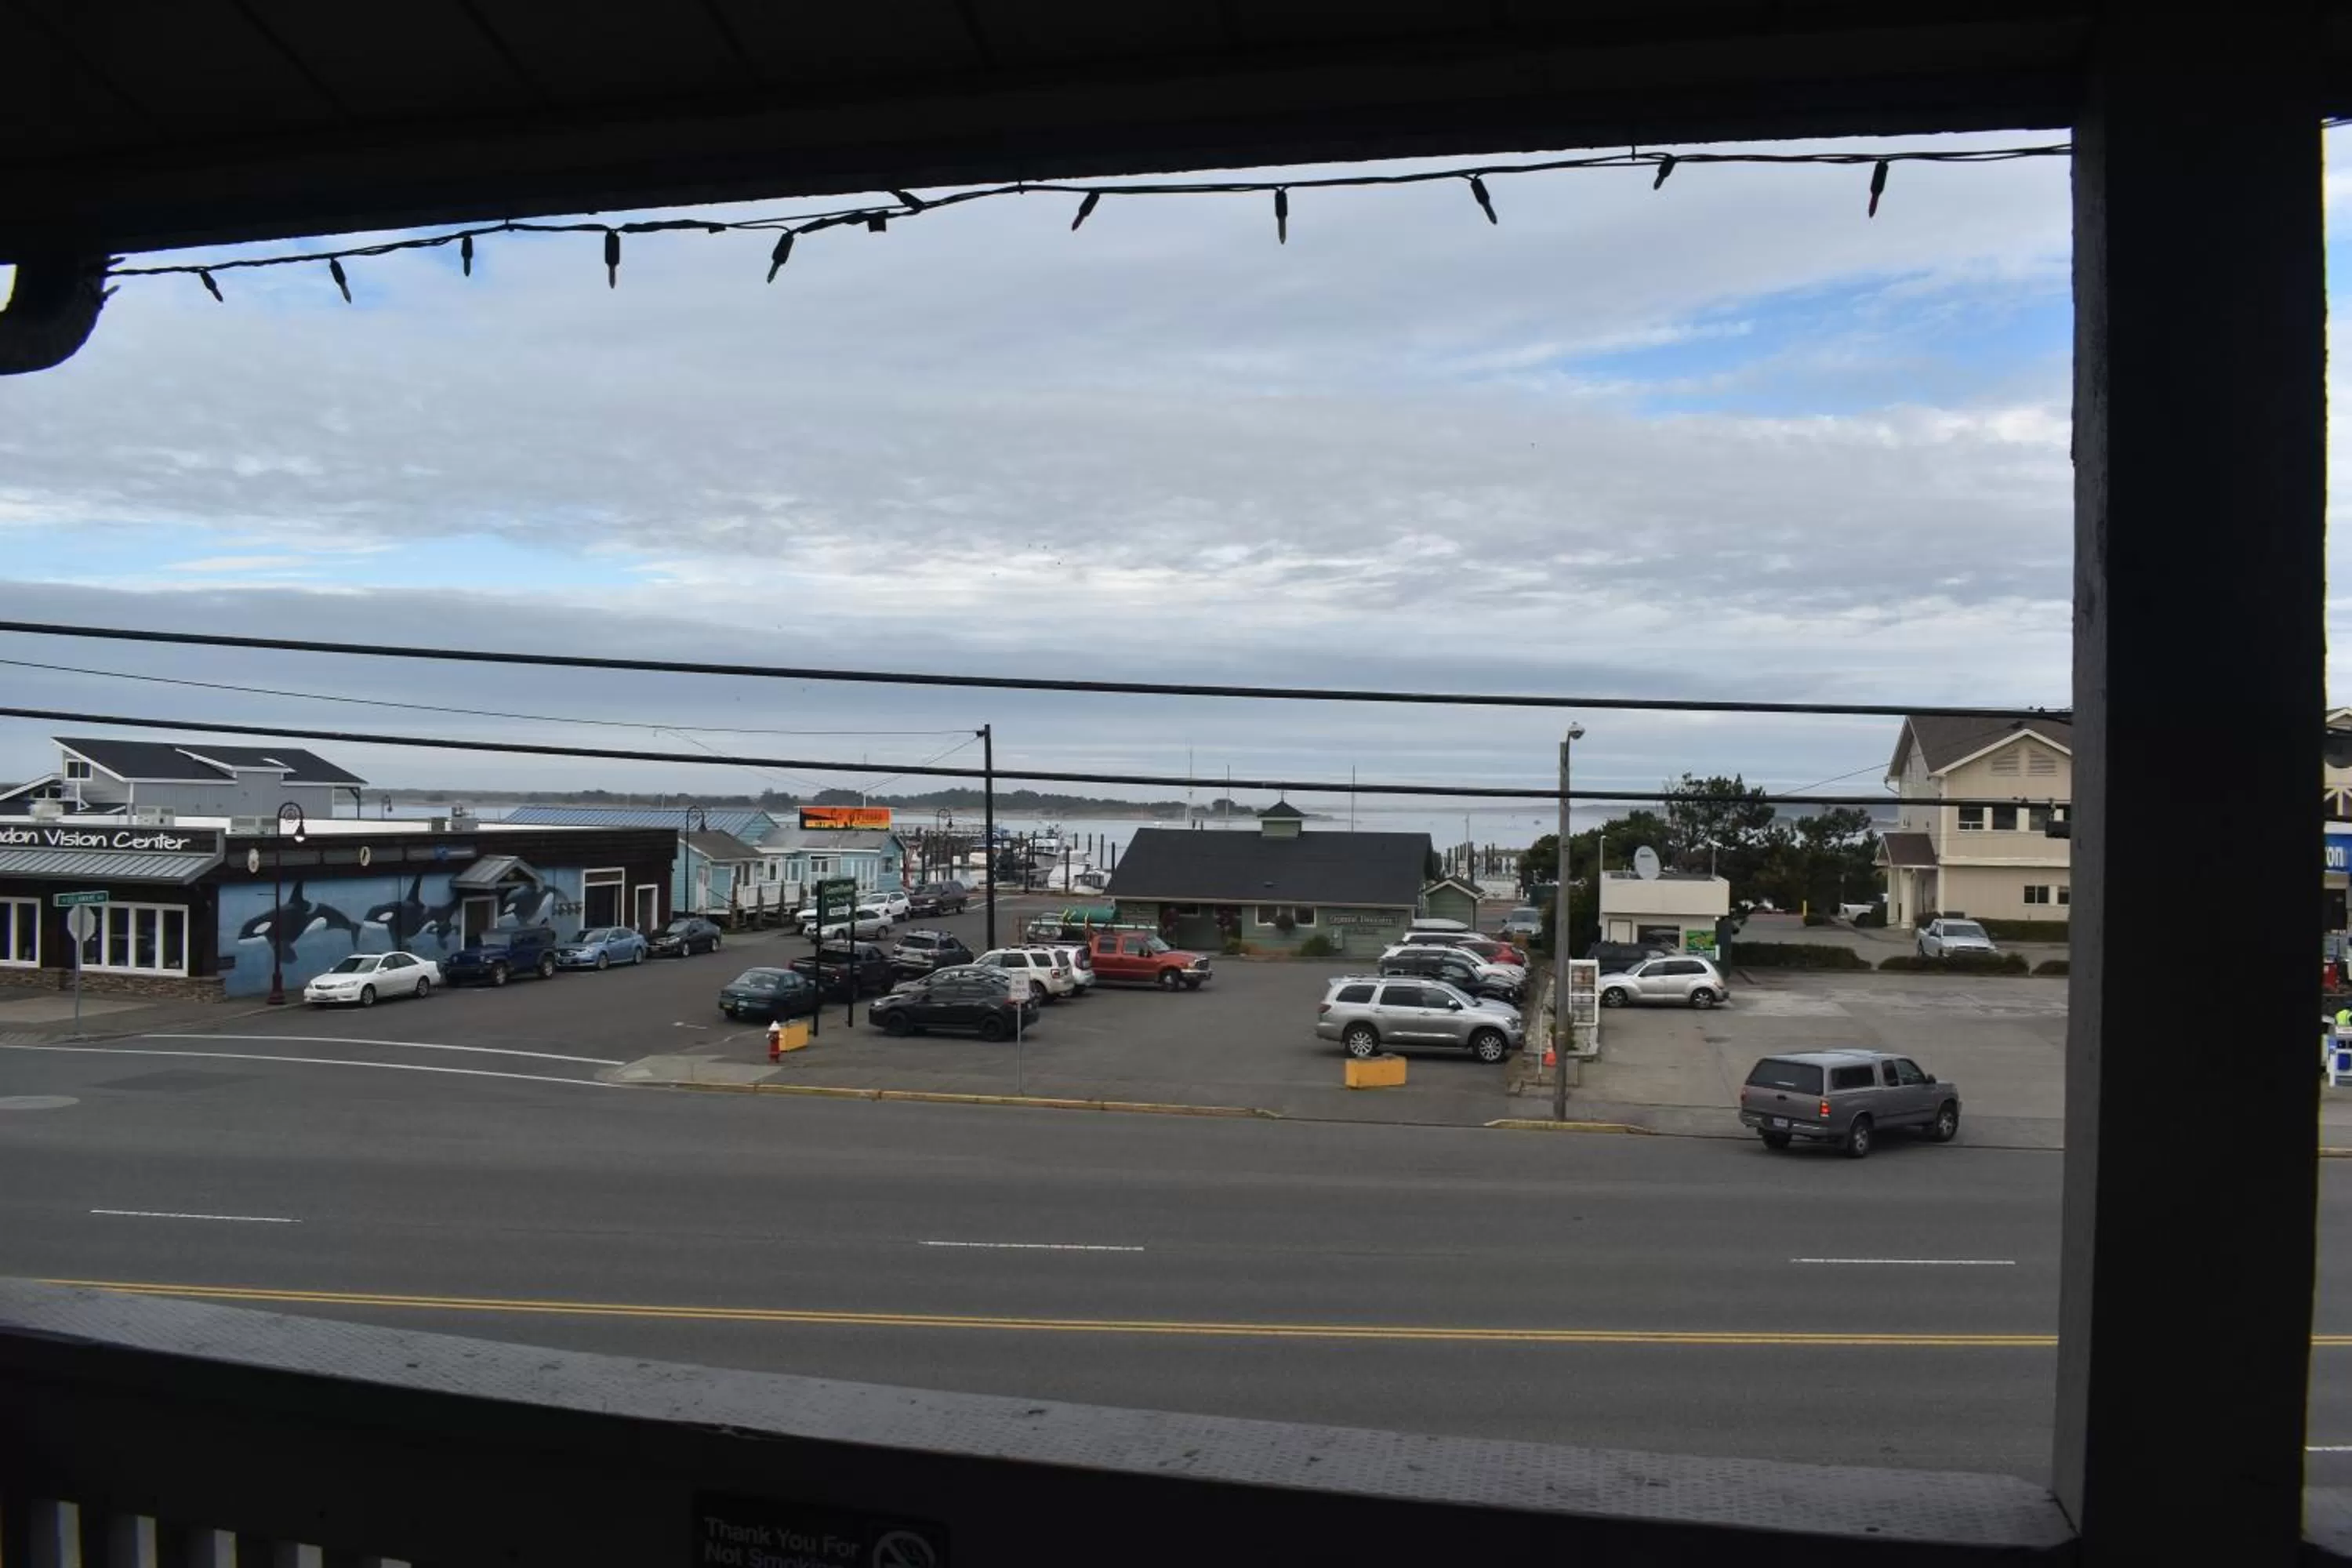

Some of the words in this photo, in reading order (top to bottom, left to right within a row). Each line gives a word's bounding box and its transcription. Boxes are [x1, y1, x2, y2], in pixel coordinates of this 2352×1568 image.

[44, 829, 107, 847] Vision
[113, 832, 191, 850] Center
[2325, 846, 2343, 867] on
[703, 1516, 771, 1545] Thank
[776, 1528, 817, 1552] You
[823, 1534, 861, 1558] For
[704, 1540, 742, 1566] Not
